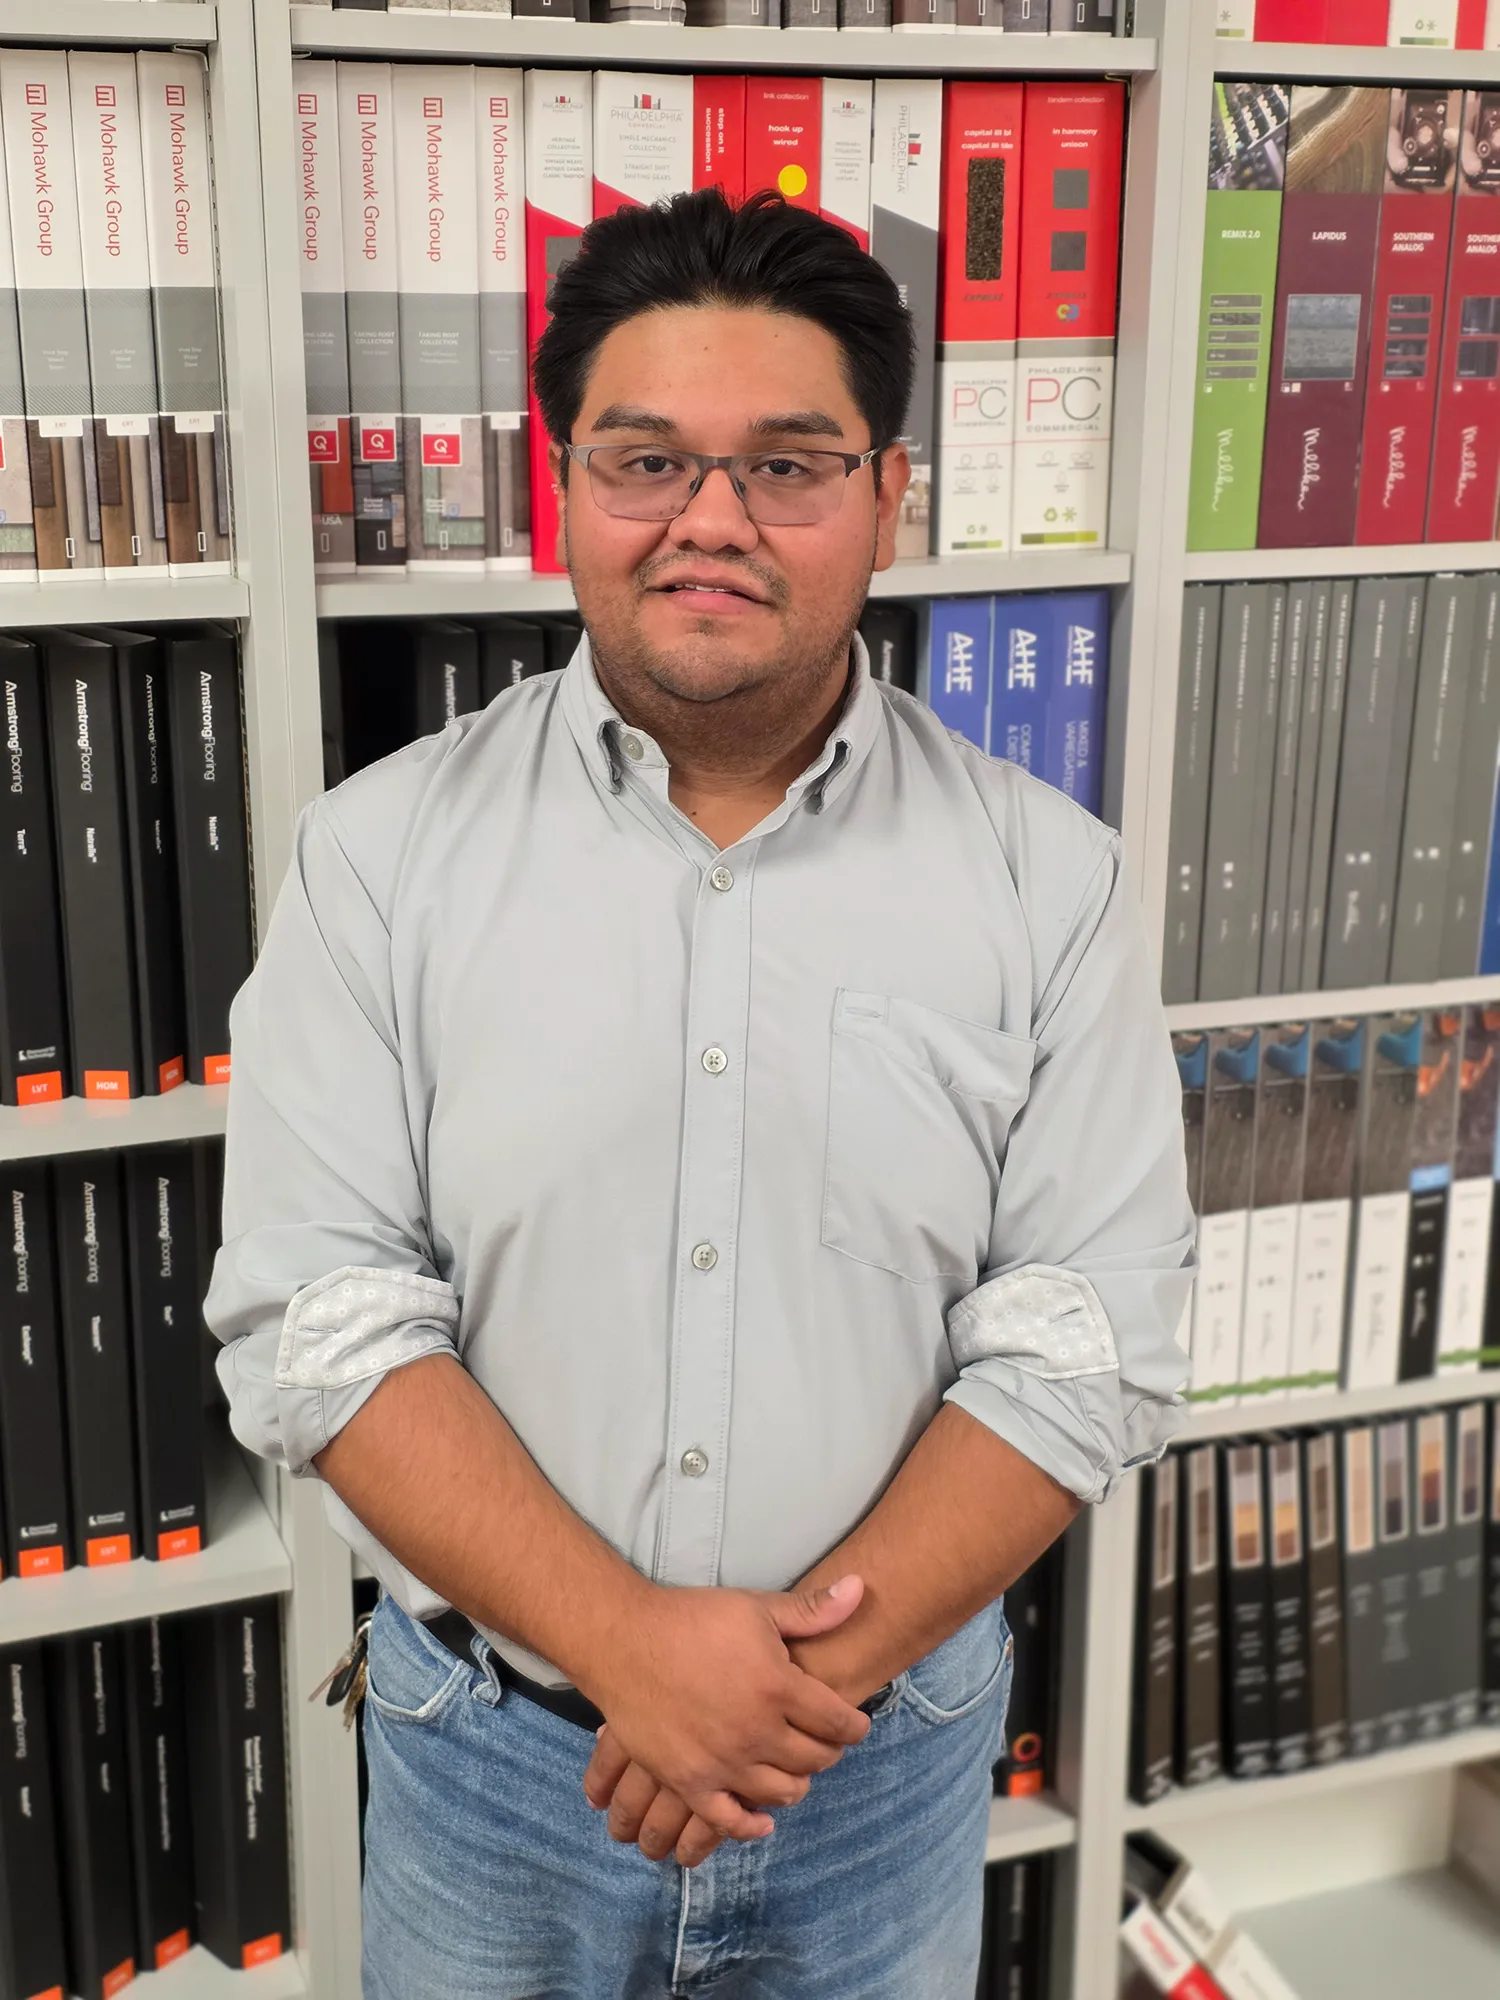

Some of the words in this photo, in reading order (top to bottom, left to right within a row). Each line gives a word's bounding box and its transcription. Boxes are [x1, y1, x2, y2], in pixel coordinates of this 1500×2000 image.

[763, 92, 775, 100] link
[1074, 96, 1105, 104] collection
[611, 110, 684, 122] PHILADELPHIA
[964, 129, 993, 137] capital
[1061, 128, 1098, 137] harmony
[30, 112, 52, 194] Mohawk
[100, 113, 121, 195] Mohawk
[170, 113, 189, 194] Mohawk
[628, 144, 667, 152] COLLECTION
[718, 131, 724, 145] on
[773, 138, 798, 146] wired
[897, 105, 908, 193] PHILADELPHIA
[962, 142, 991, 150] capital
[301, 121, 319, 201] Mohawk
[361, 121, 379, 201] Mohawk
[426, 124, 444, 203] Mohawk
[492, 124, 509, 202] Mohawk
[37, 199, 54, 256] Group
[105, 200, 122, 257] Group
[174, 199, 191, 255] Group
[303, 206, 320, 261] Group
[362, 206, 379, 260] Group
[426, 208, 444, 262] Group
[492, 207, 509, 261] Group
[1222, 230, 1247, 239] REMIX
[1248, 230, 1261, 239] 2.0
[1312, 231, 1347, 241] LAPIDUS
[1392, 232, 1435, 241] SOUTHERN
[1392, 243, 1425, 252] ANALOG
[1466, 244, 1498, 254] ANALOG
[441, 331, 460, 339] ROOT
[1028, 366, 1103, 375] PHILADELPHIA
[953, 386, 1007, 420] PC
[1026, 375, 1102, 422] PC
[1026, 424, 1100, 433] COMMERCIAL
[322, 515, 343, 525] USA
[953, 632, 974, 692] AHF
[1014, 628, 1037, 688] AHF
[1072, 625, 1096, 685] AHF
[445, 663, 456, 727] Armstron
[1078, 720, 1089, 757] MIXED
[32, 1083, 48, 1094] LVT
[96, 1081, 118, 1091] HOM
